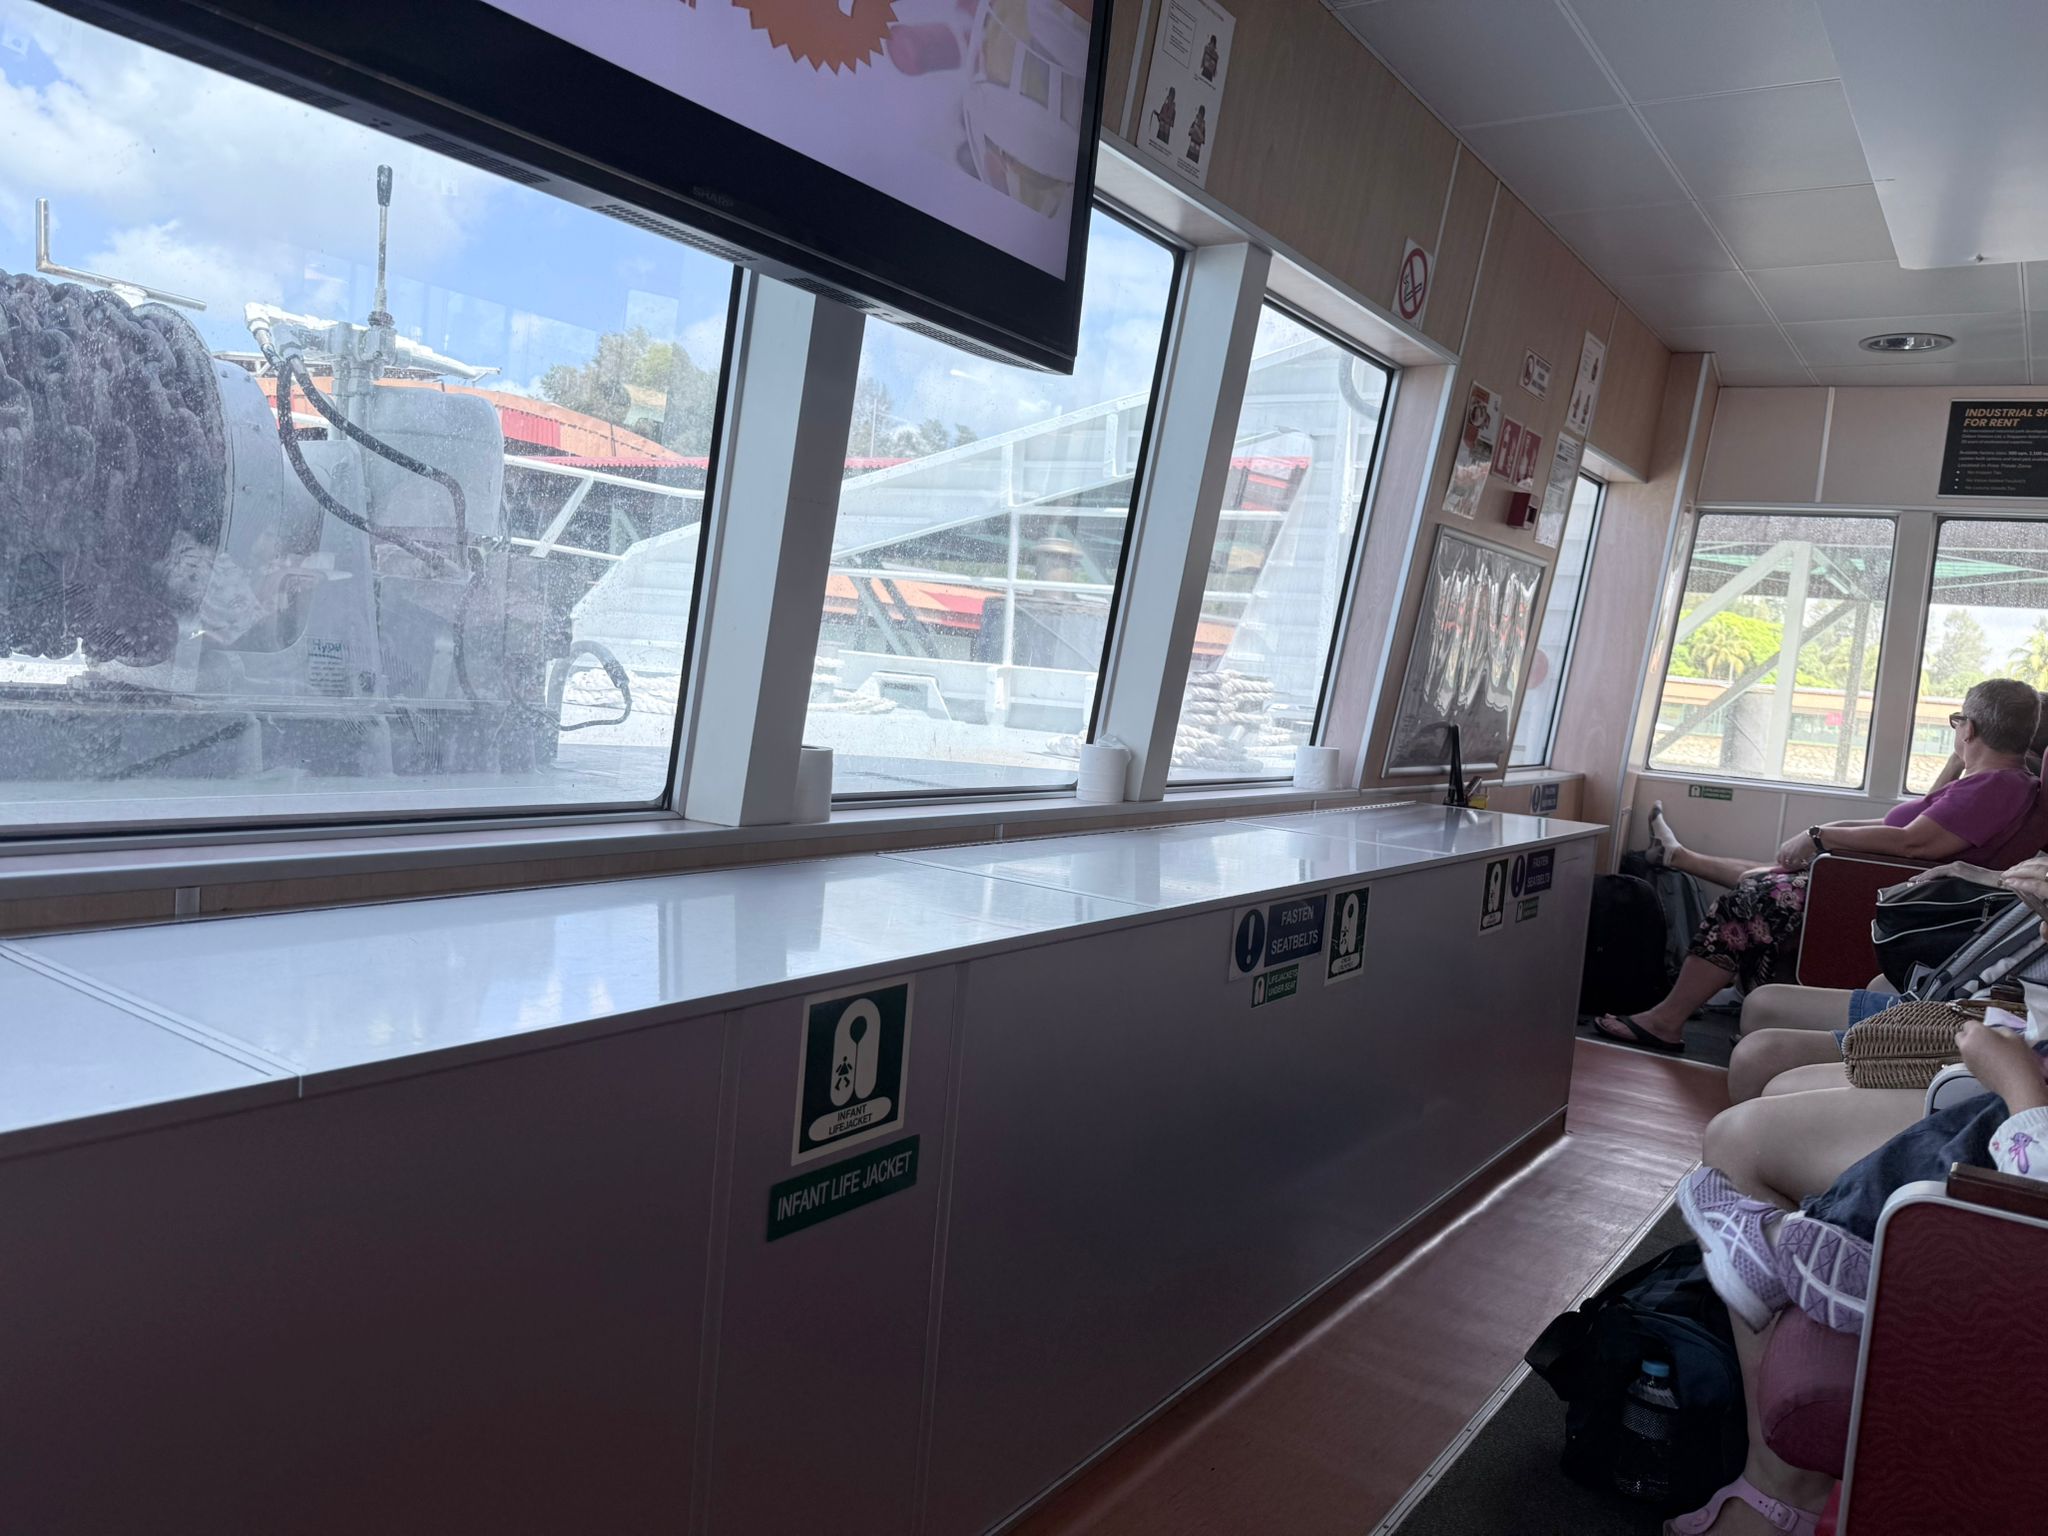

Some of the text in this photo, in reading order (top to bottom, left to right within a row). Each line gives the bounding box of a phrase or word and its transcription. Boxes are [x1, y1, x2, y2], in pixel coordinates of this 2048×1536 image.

[1963, 418, 2021, 427] FOR RENT
[1965, 408, 2033, 417] INDUSTRIAL
[1281, 905, 1314, 926] FASTEN
[1271, 929, 1319, 955] SEATBELTS
[837, 1103, 868, 1121] INFANT
[828, 1112, 873, 1136] LIFEJACKET
[777, 1151, 913, 1221] INFANT LIFE JACKET
